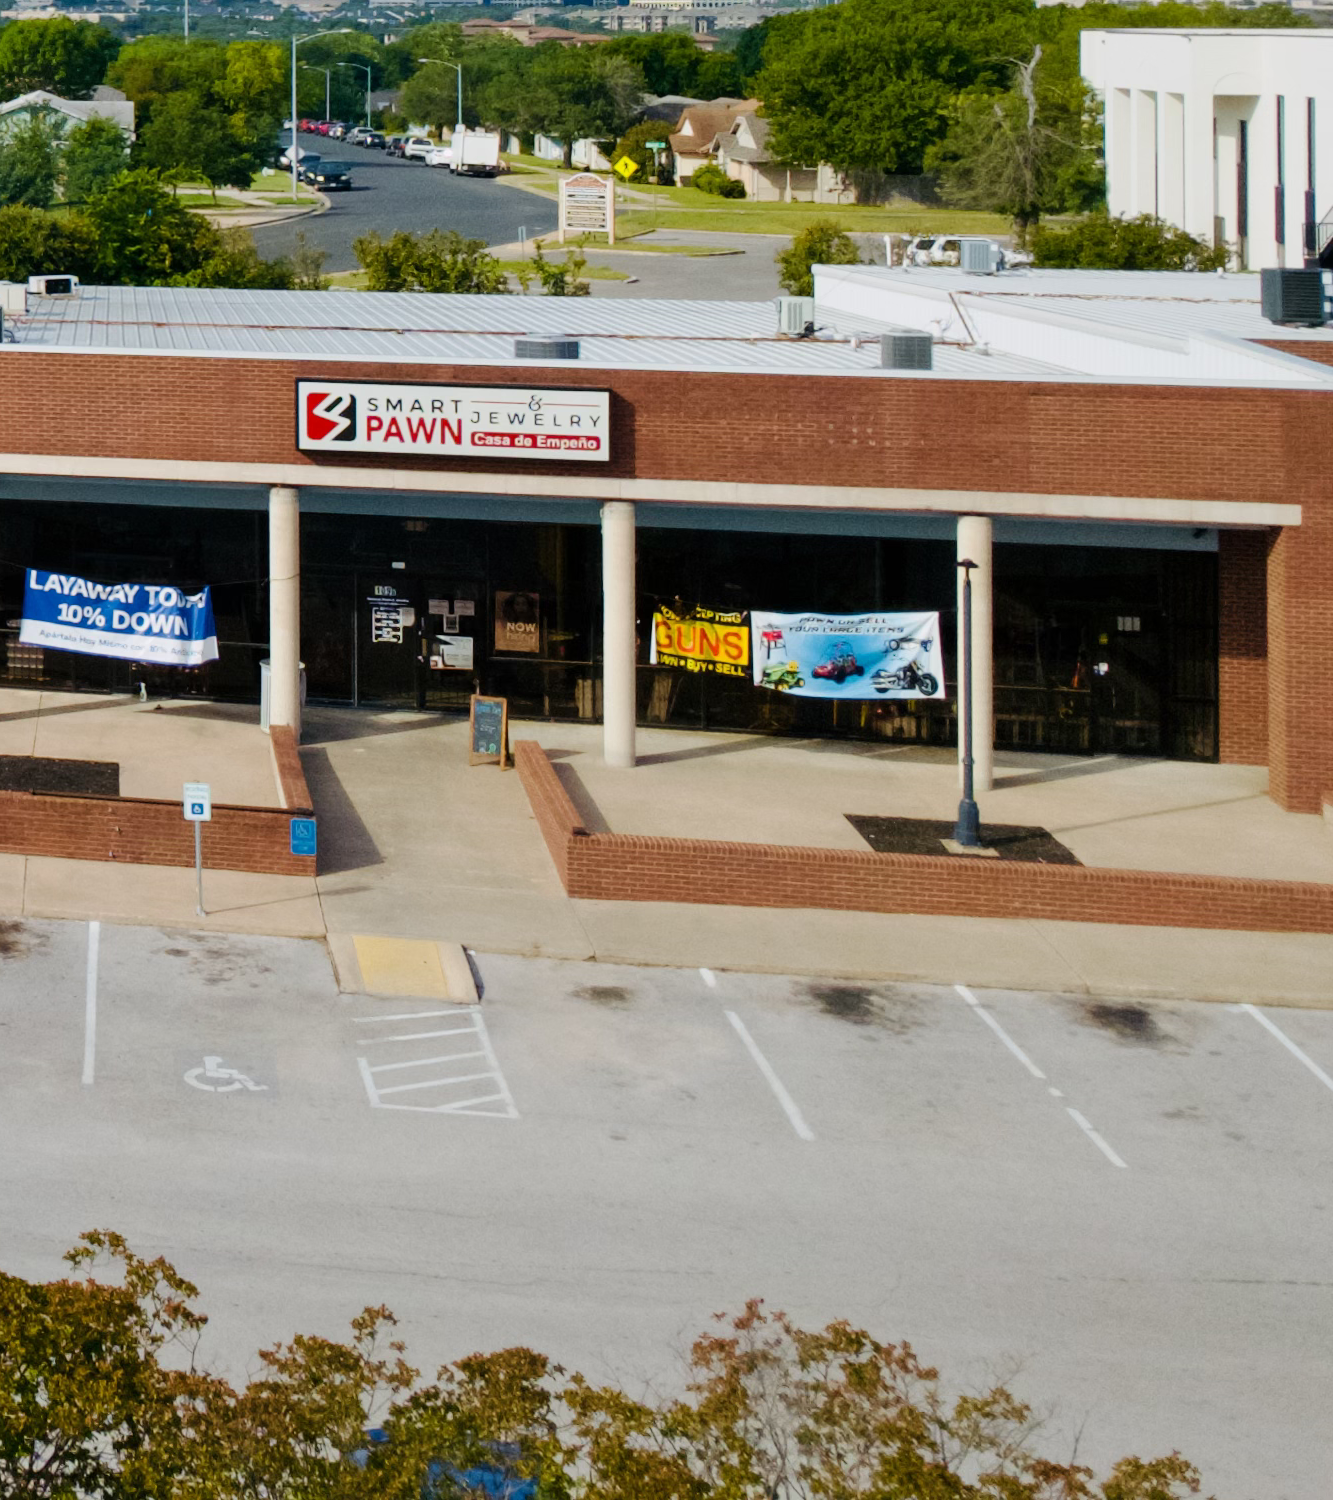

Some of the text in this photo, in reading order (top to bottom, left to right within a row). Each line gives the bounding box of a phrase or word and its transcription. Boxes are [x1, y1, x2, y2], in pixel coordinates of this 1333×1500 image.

[366, 397, 463, 414] SMART
[527, 394, 542, 412] &
[470, 410, 602, 428] JEWELRY
[365, 415, 463, 445] PAWN
[473, 432, 598, 450] Casa de Empeño
[29, 569, 140, 604] LAYAWAY
[57, 602, 189, 636] 10% DOWN
[506, 621, 536, 632] NOW
[656, 619, 744, 661] GUNS
[686, 658, 708, 673] BUY
[714, 663, 746, 677] SELL
